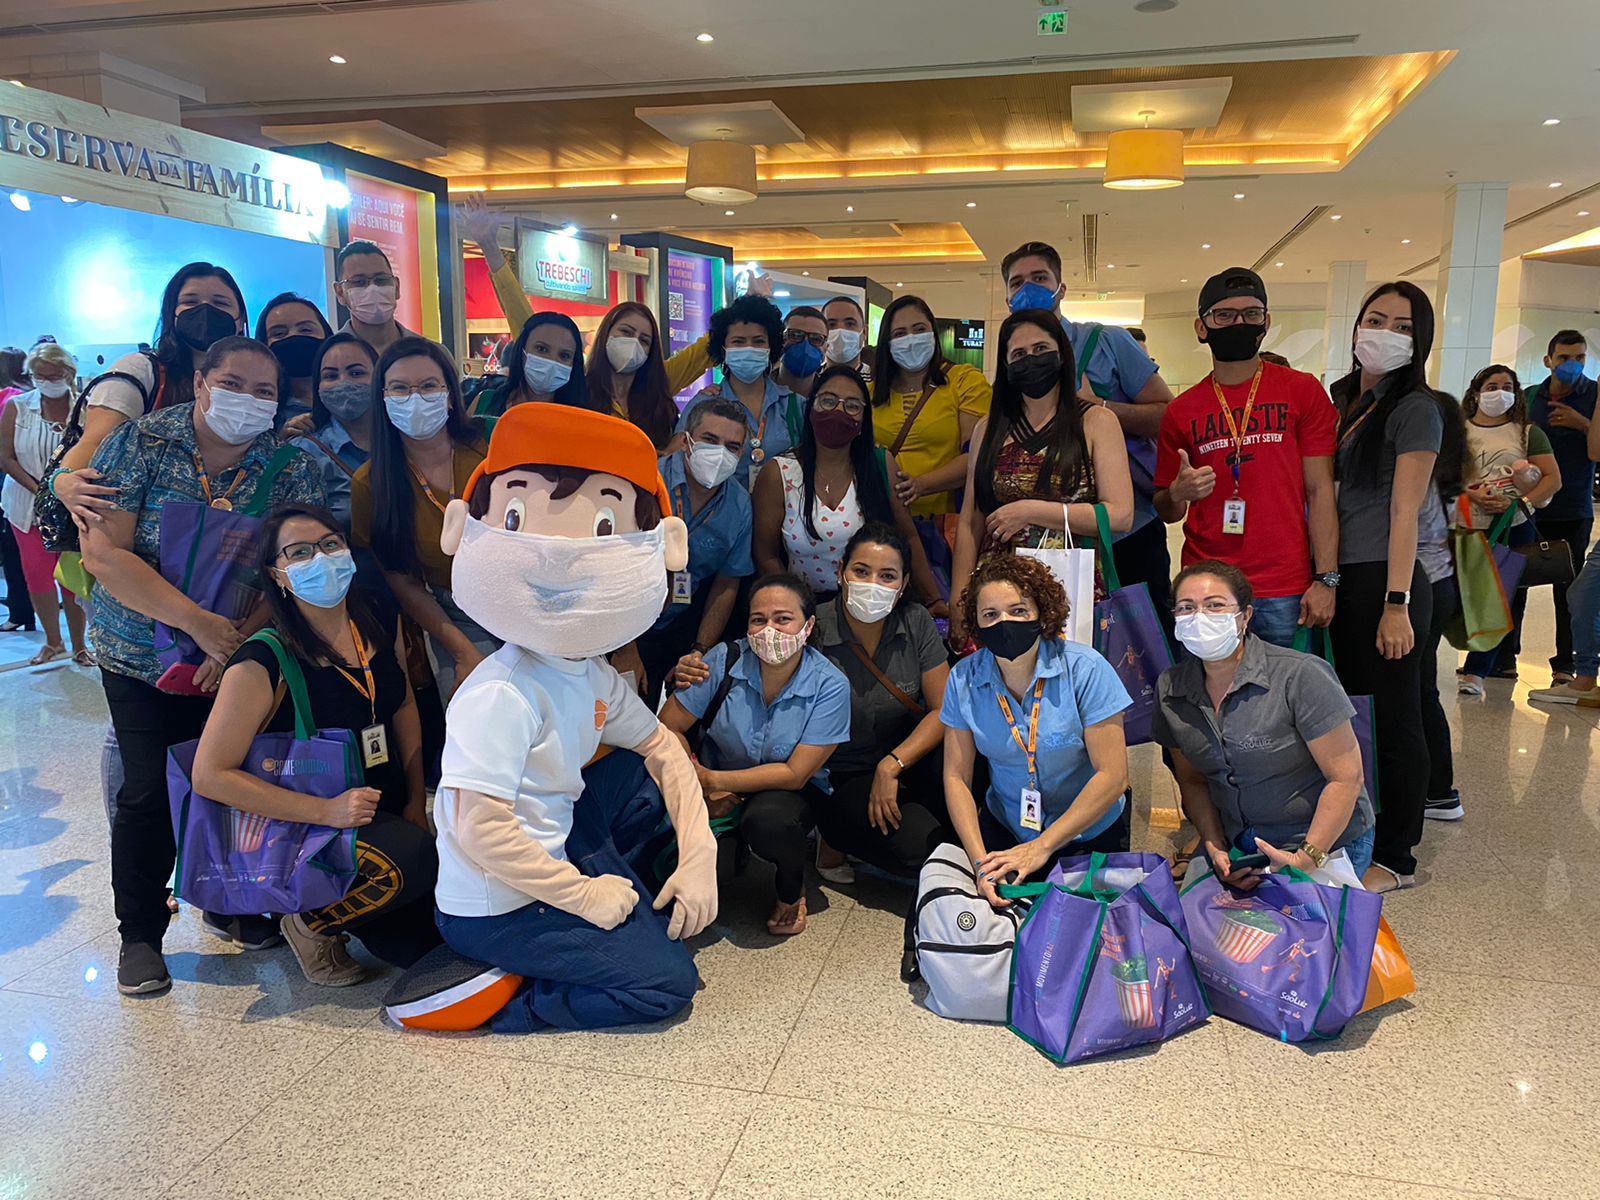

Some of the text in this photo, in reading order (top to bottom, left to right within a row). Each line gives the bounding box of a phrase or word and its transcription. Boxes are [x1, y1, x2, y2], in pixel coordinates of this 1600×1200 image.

[159, 160, 181, 180] DA
[184, 162, 313, 217] FAMÍLI
[538, 260, 591, 286] TREBESCHI
[1191, 403, 1289, 445] LACOSTE
[1199, 439, 1228, 454] NINETEEN
[1263, 433, 1283, 443] SEVEN
